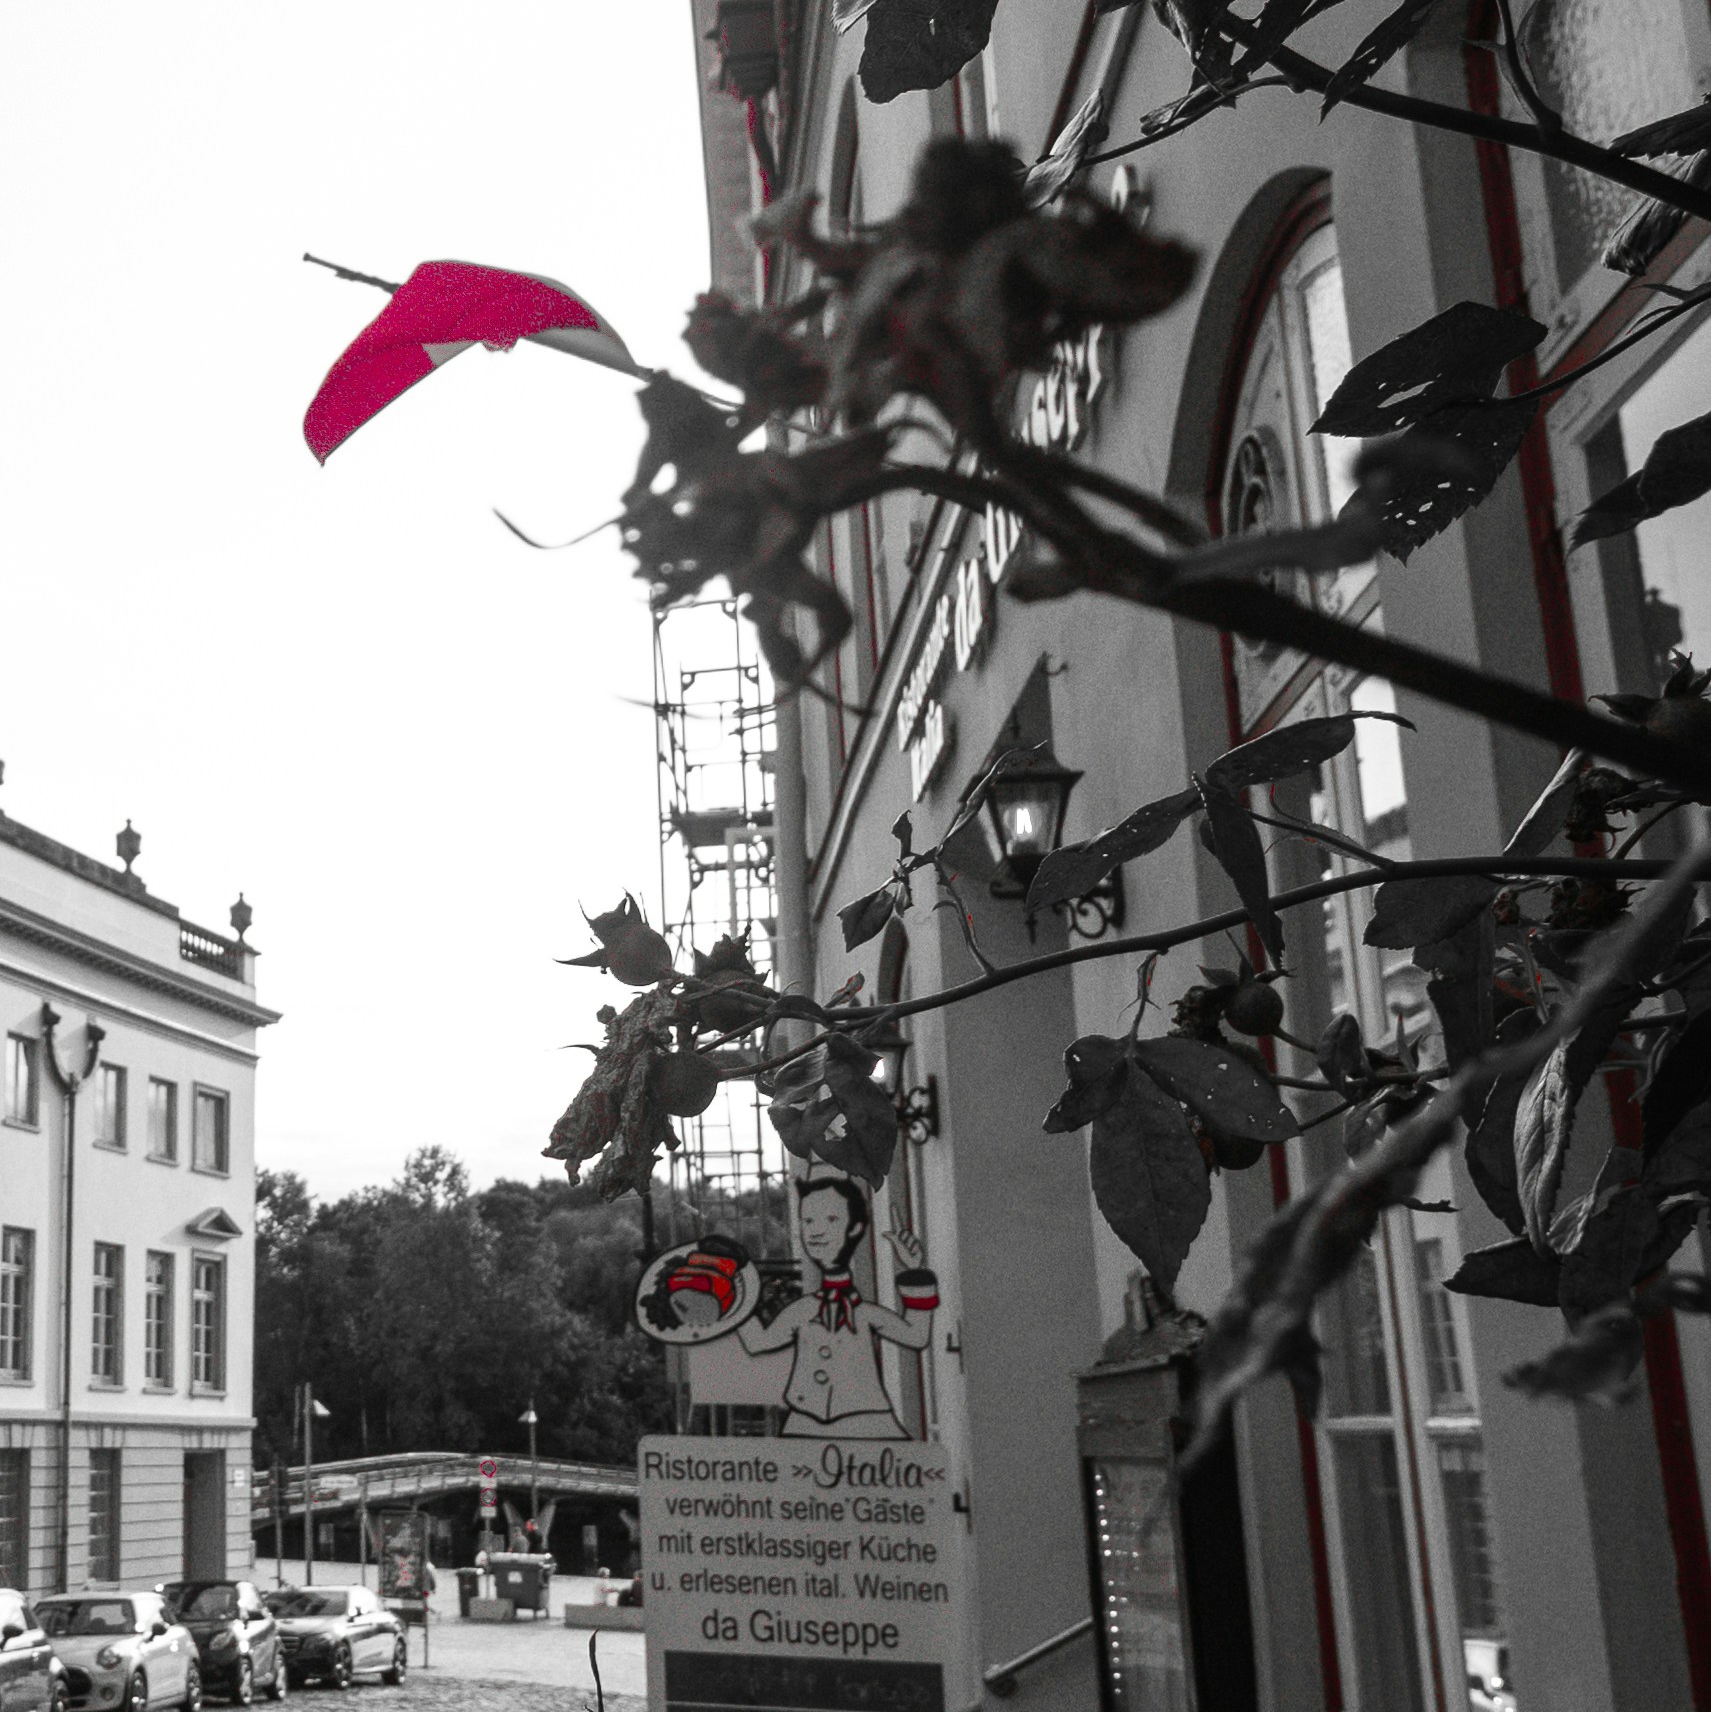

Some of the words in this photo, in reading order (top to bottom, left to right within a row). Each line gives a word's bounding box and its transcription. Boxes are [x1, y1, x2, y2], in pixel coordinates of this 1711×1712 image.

[644, 1451, 779, 1483] Ristorante
[665, 1492, 774, 1520] verwöhnt
[780, 1495, 845, 1522] seine
[852, 1496, 926, 1525] Gäste
[657, 1529, 694, 1555] mit
[700, 1531, 851, 1567] erstklassiger
[859, 1535, 938, 1564] Küche
[650, 1571, 672, 1591] u.
[679, 1568, 797, 1596] erlesenen
[804, 1572, 846, 1599] ital.
[853, 1572, 949, 1603] Weinen
[701, 1608, 739, 1641] da
[749, 1609, 900, 1656] Giuseppe
